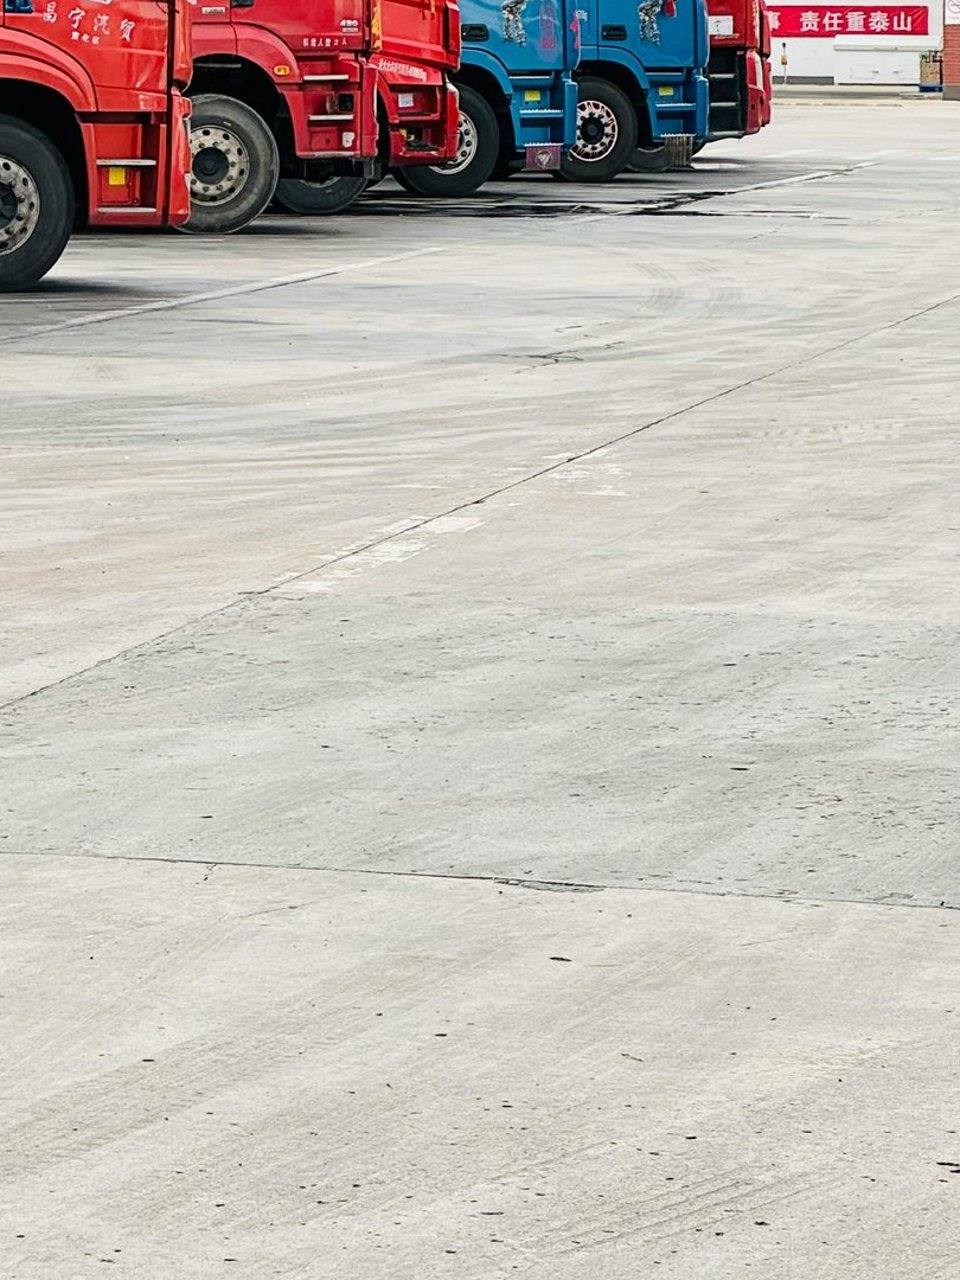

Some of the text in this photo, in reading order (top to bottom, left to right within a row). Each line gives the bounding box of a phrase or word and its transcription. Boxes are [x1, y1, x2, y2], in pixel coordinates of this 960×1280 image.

[800, 10, 913, 33] 责任重泰山
